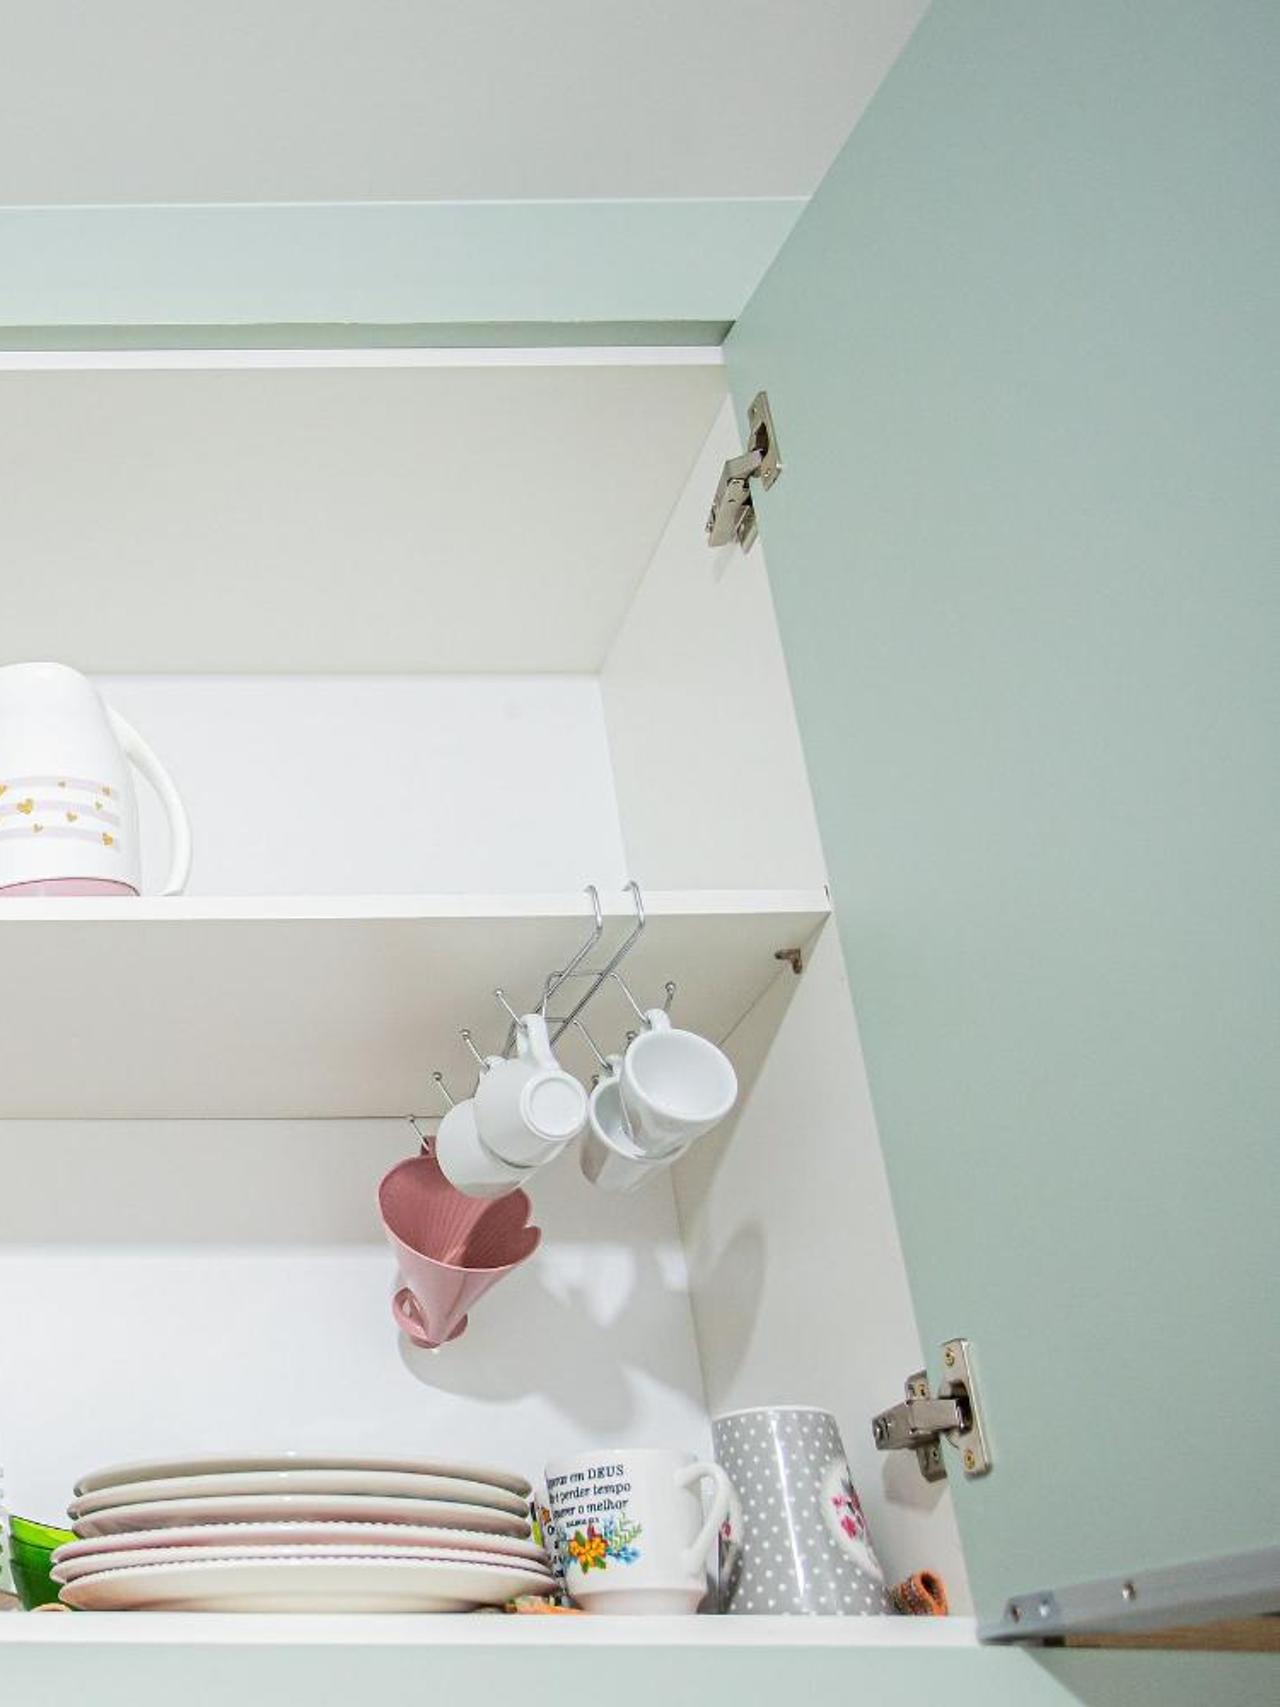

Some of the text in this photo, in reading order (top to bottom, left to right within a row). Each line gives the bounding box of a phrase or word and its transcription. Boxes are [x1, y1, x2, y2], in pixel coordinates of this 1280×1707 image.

[570, 1472, 585, 1482] em
[587, 1463, 624, 1480] DEUS
[593, 1483, 631, 1496] tempo
[586, 1498, 629, 1513] melhor
